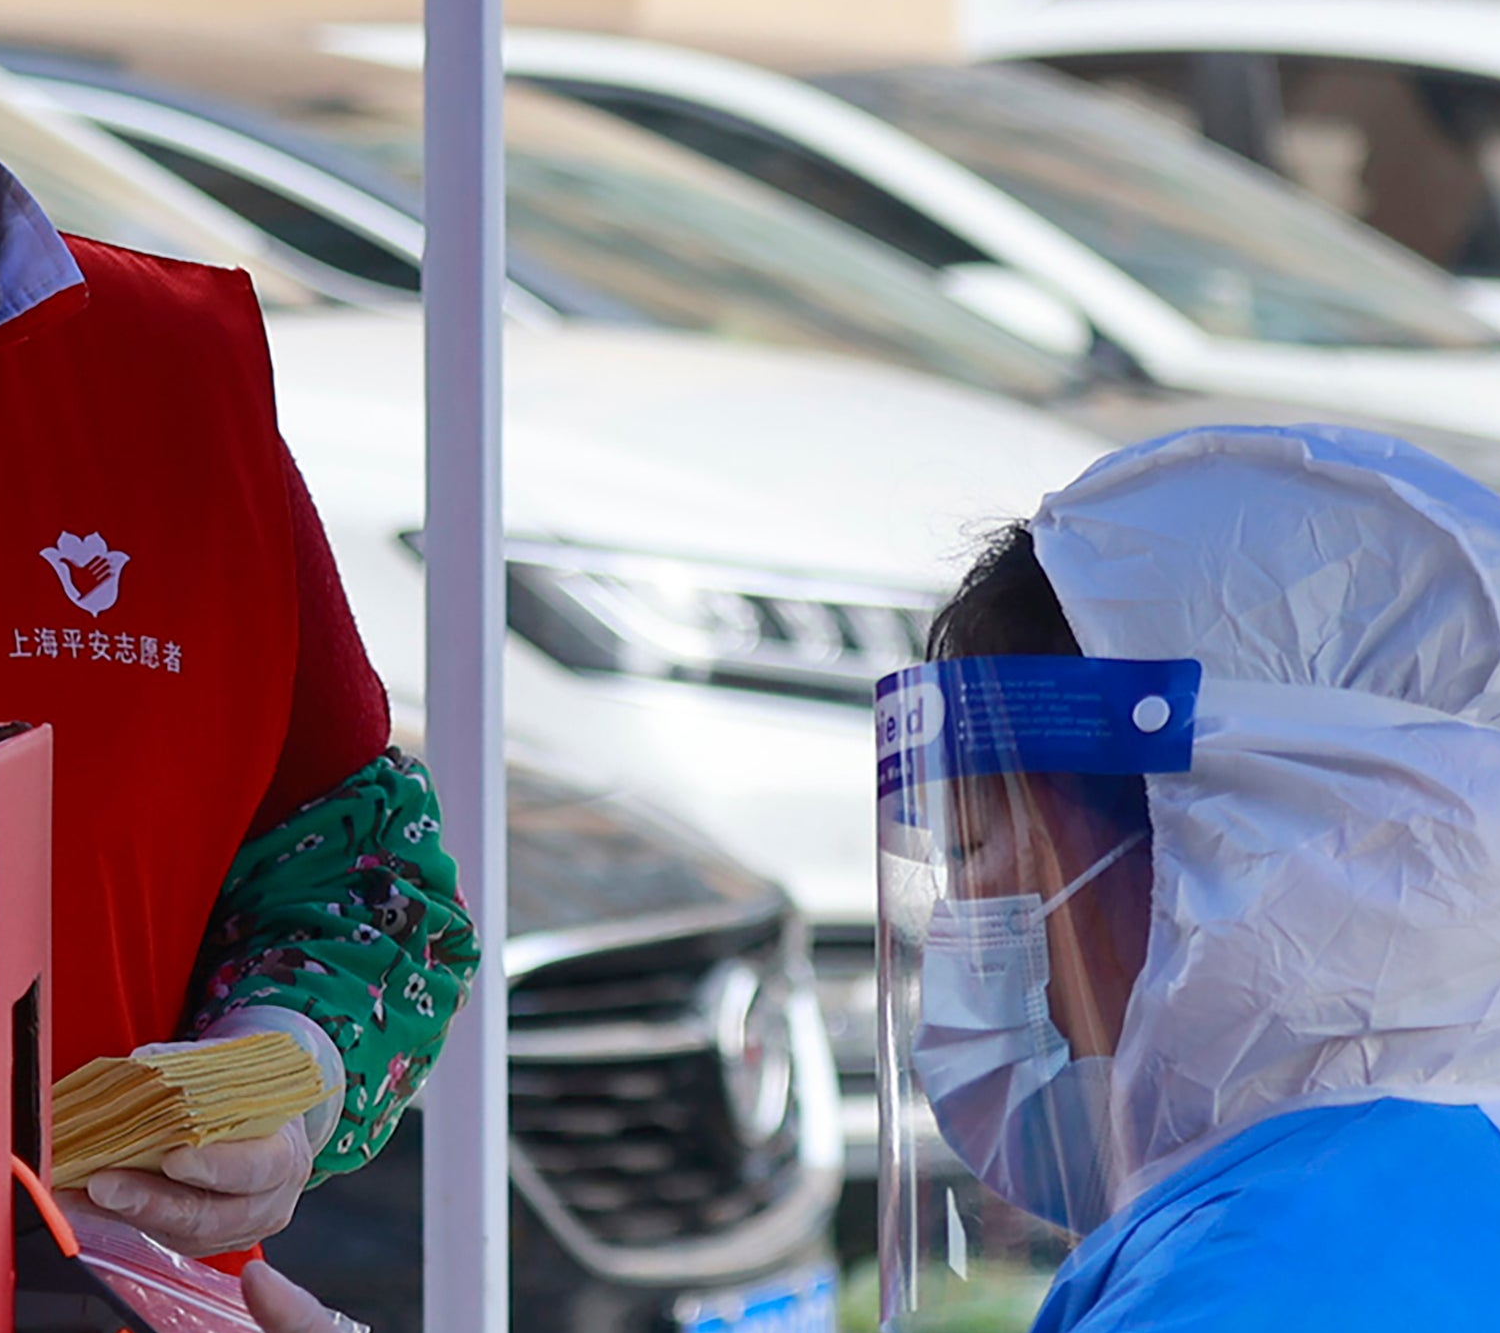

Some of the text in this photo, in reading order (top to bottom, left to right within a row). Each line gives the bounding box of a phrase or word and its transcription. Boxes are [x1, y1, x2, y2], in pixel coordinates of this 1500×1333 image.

[9, 627, 183, 674] 上海平安志愿者
